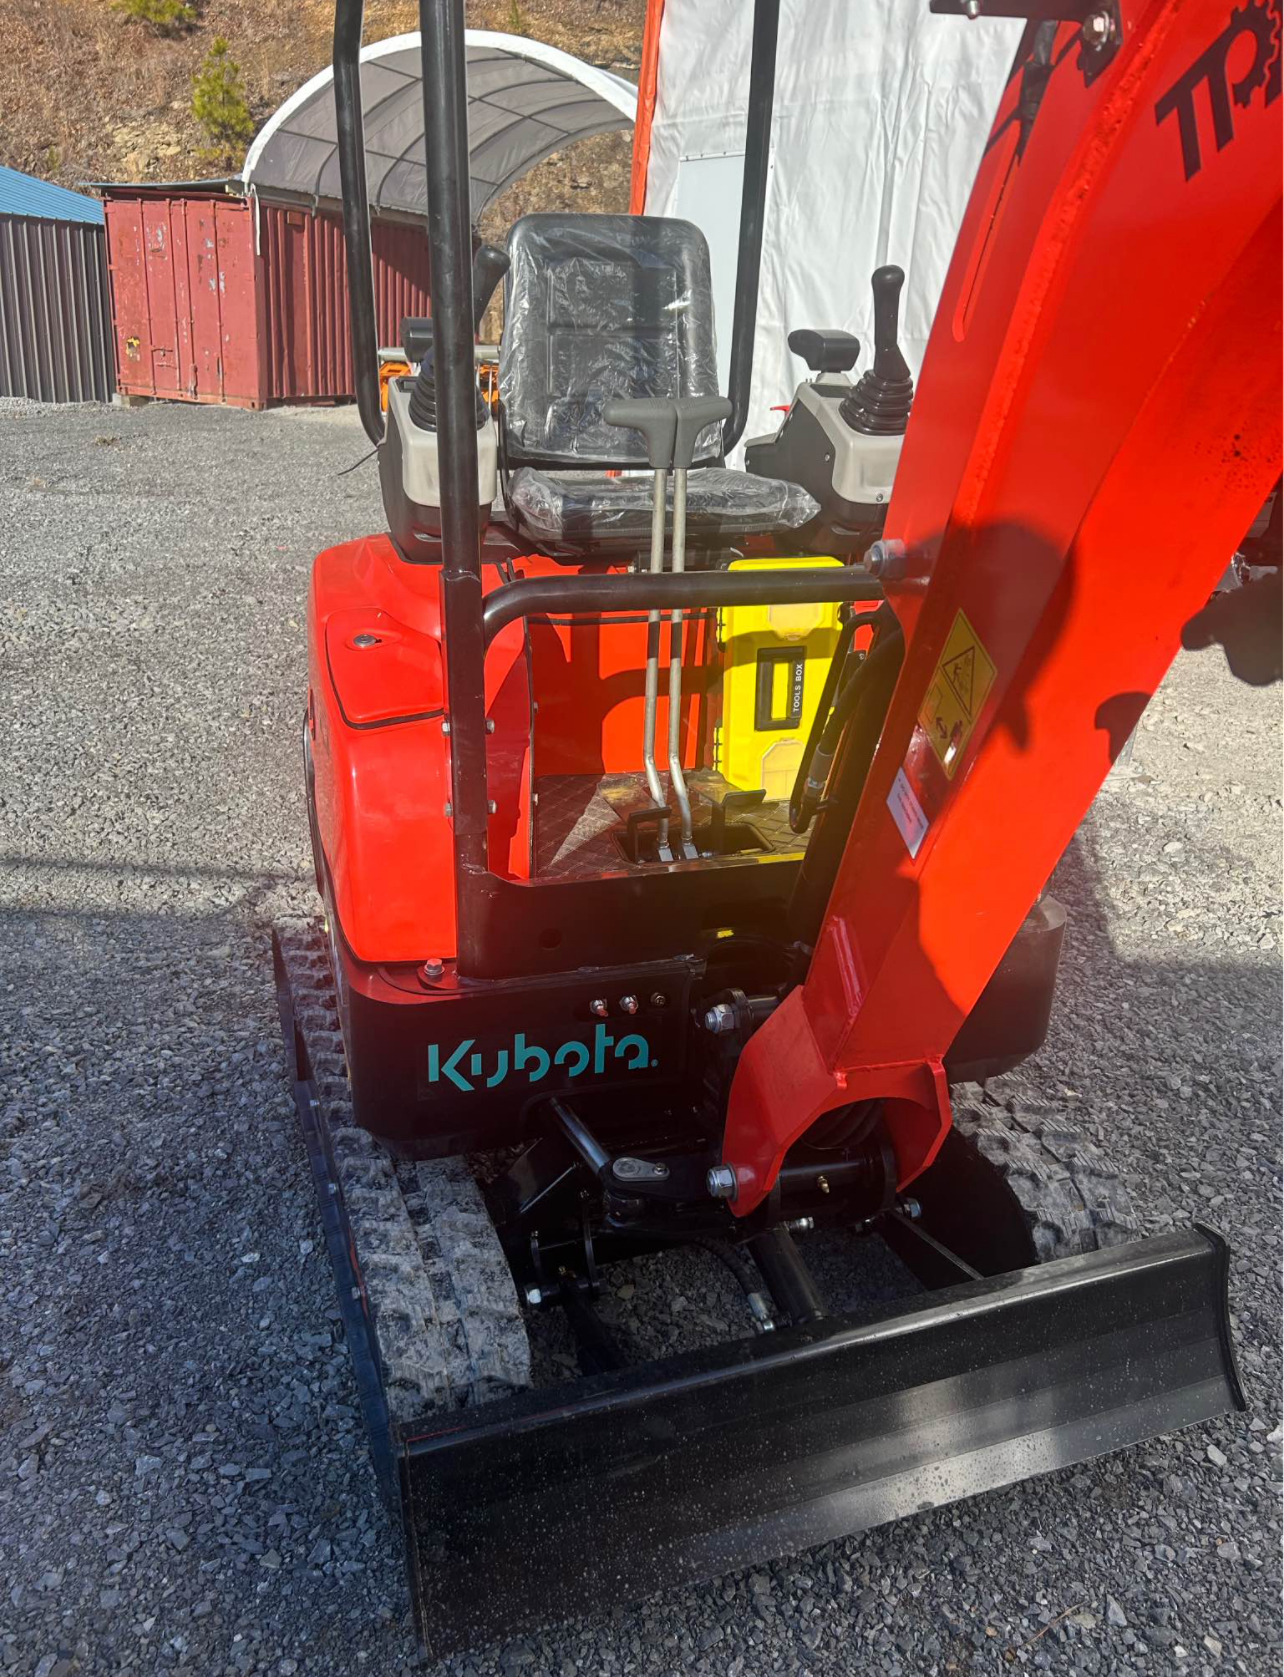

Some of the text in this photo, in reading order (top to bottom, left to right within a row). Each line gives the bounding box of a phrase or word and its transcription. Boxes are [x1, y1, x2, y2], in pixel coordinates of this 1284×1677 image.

[793, 664, 803, 712] TOOLS BOX
[428, 1023, 650, 1091] Kubota
